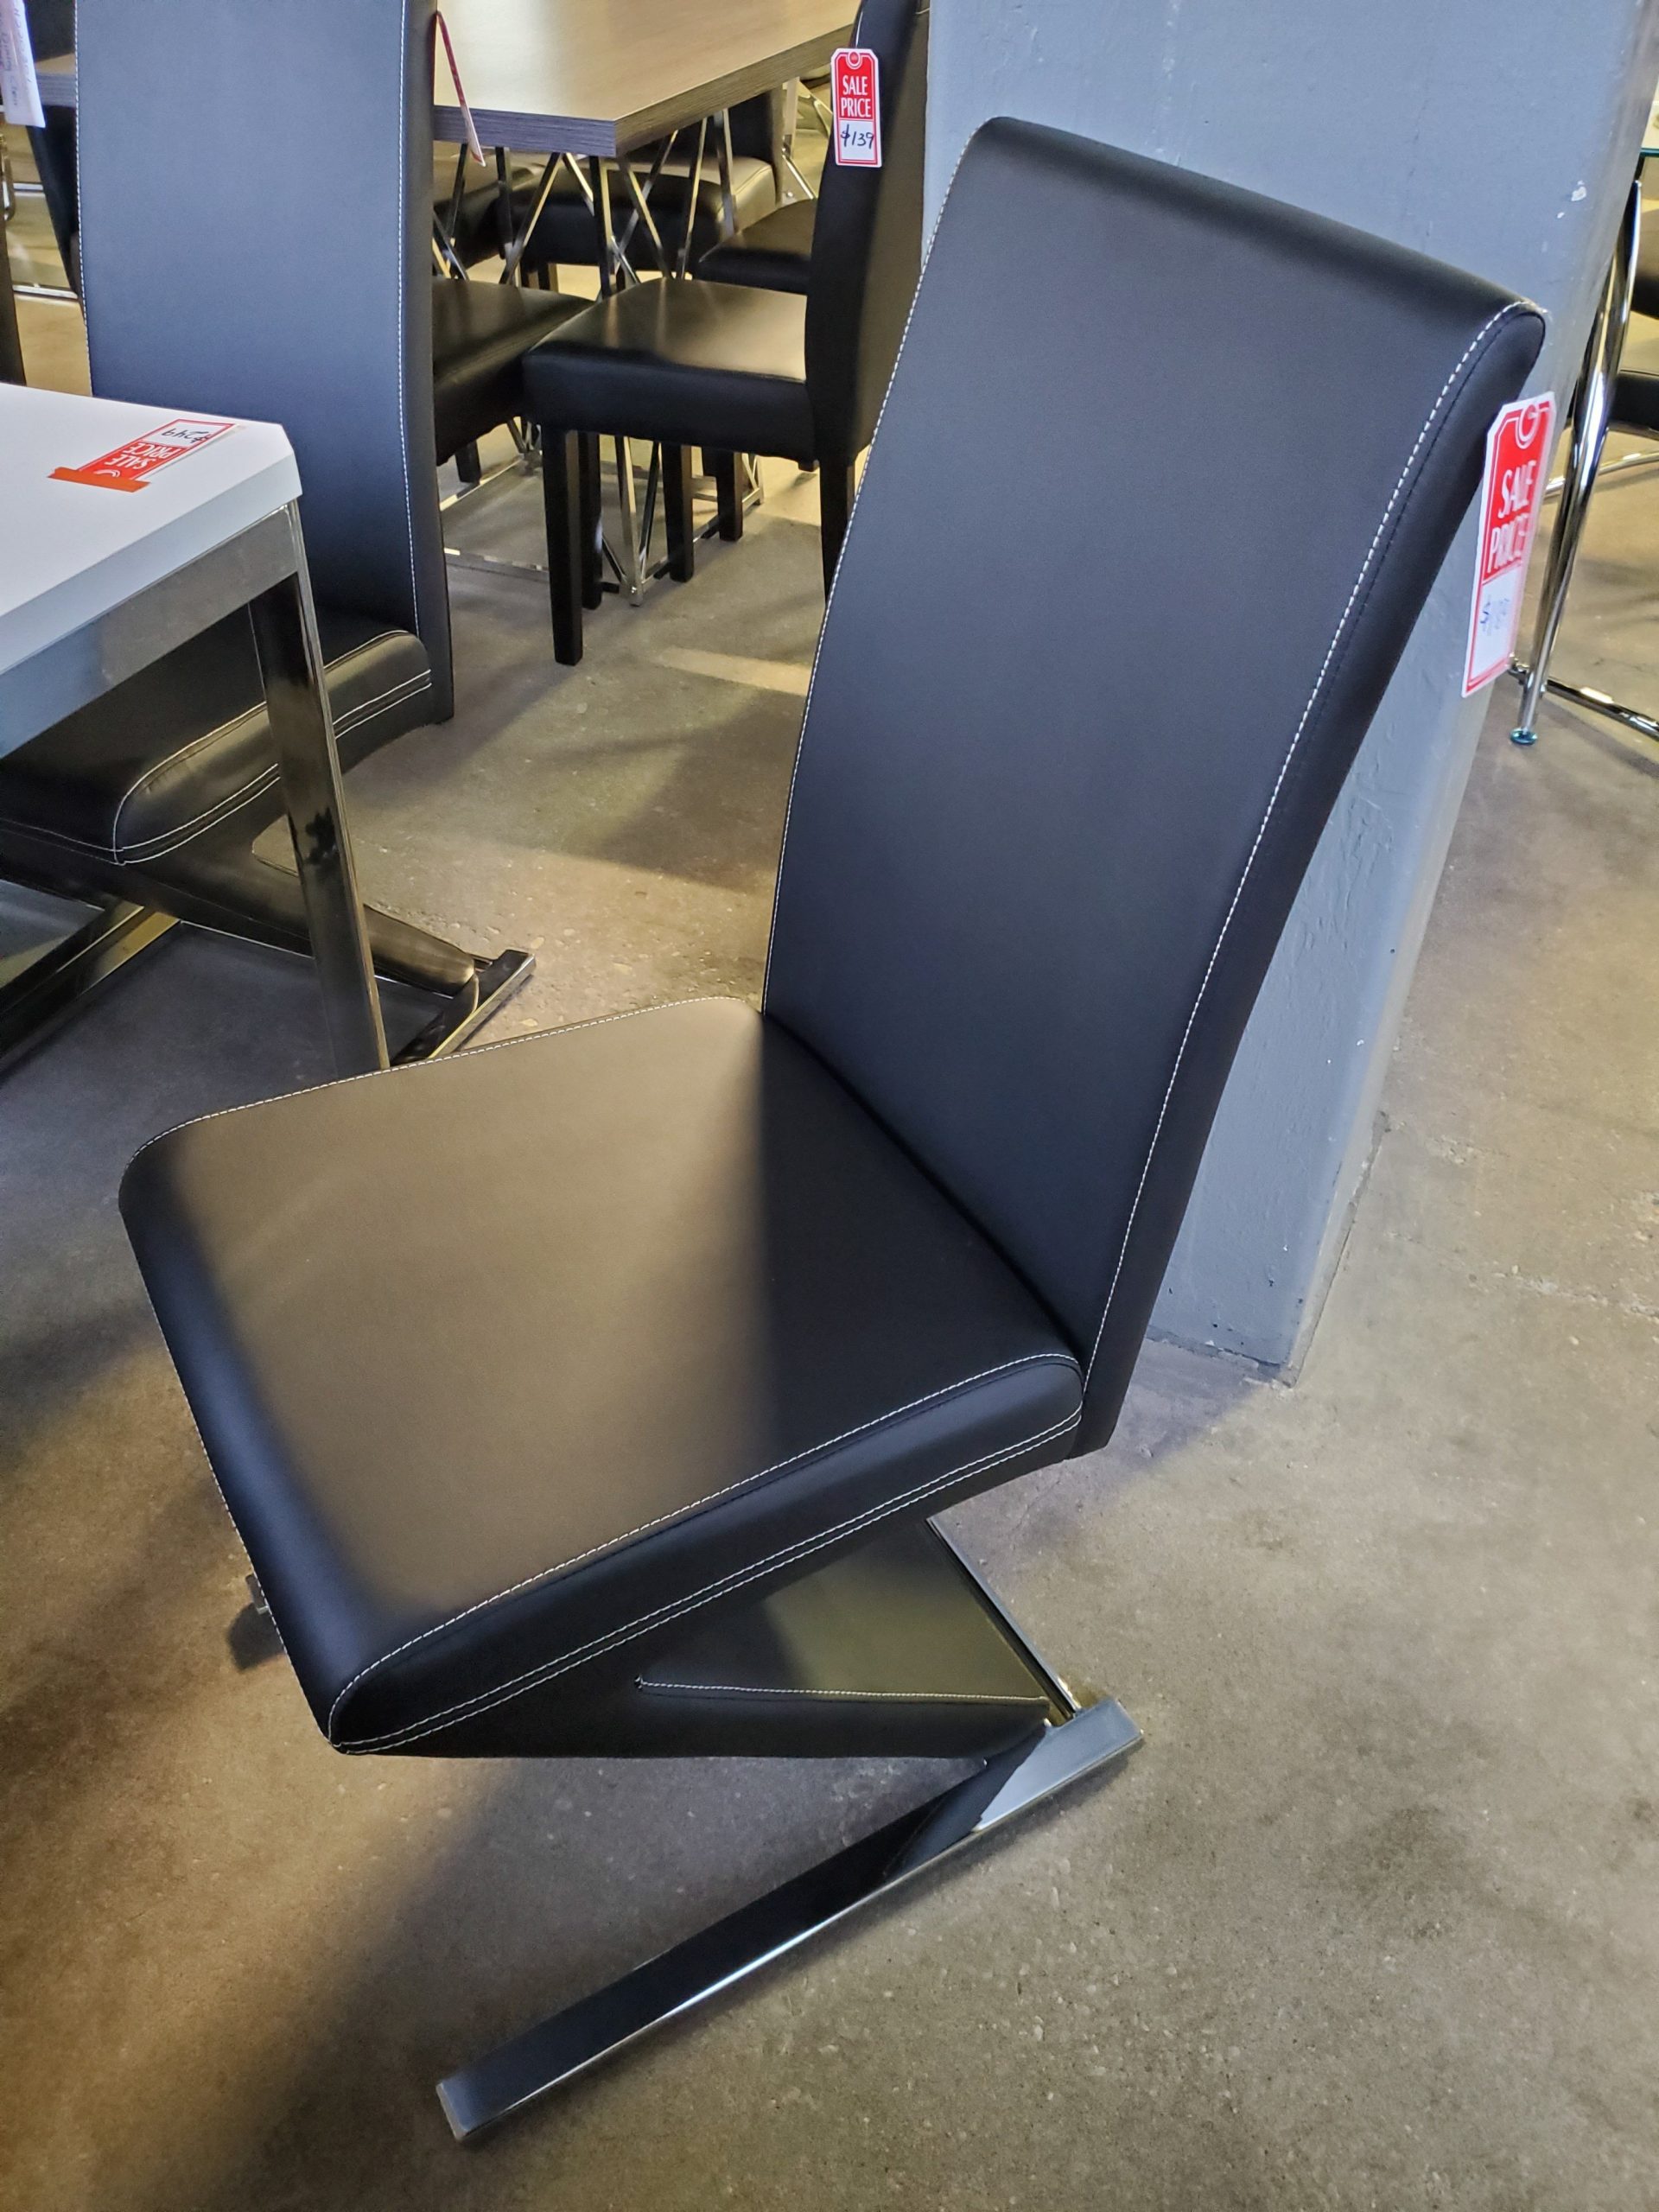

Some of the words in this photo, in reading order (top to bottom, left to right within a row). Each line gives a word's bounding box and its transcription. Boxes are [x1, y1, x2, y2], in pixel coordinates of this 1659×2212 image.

[842, 74, 868, 96] SALE
[840, 97, 872, 118] PRICE
[840, 124, 874, 149] $139
[161, 428, 211, 443] $249
[122, 442, 182, 459] PRICE
[104, 454, 157, 470] SALE
[1497, 460, 1536, 518] SALE
[1487, 512, 1529, 574] PRICE
